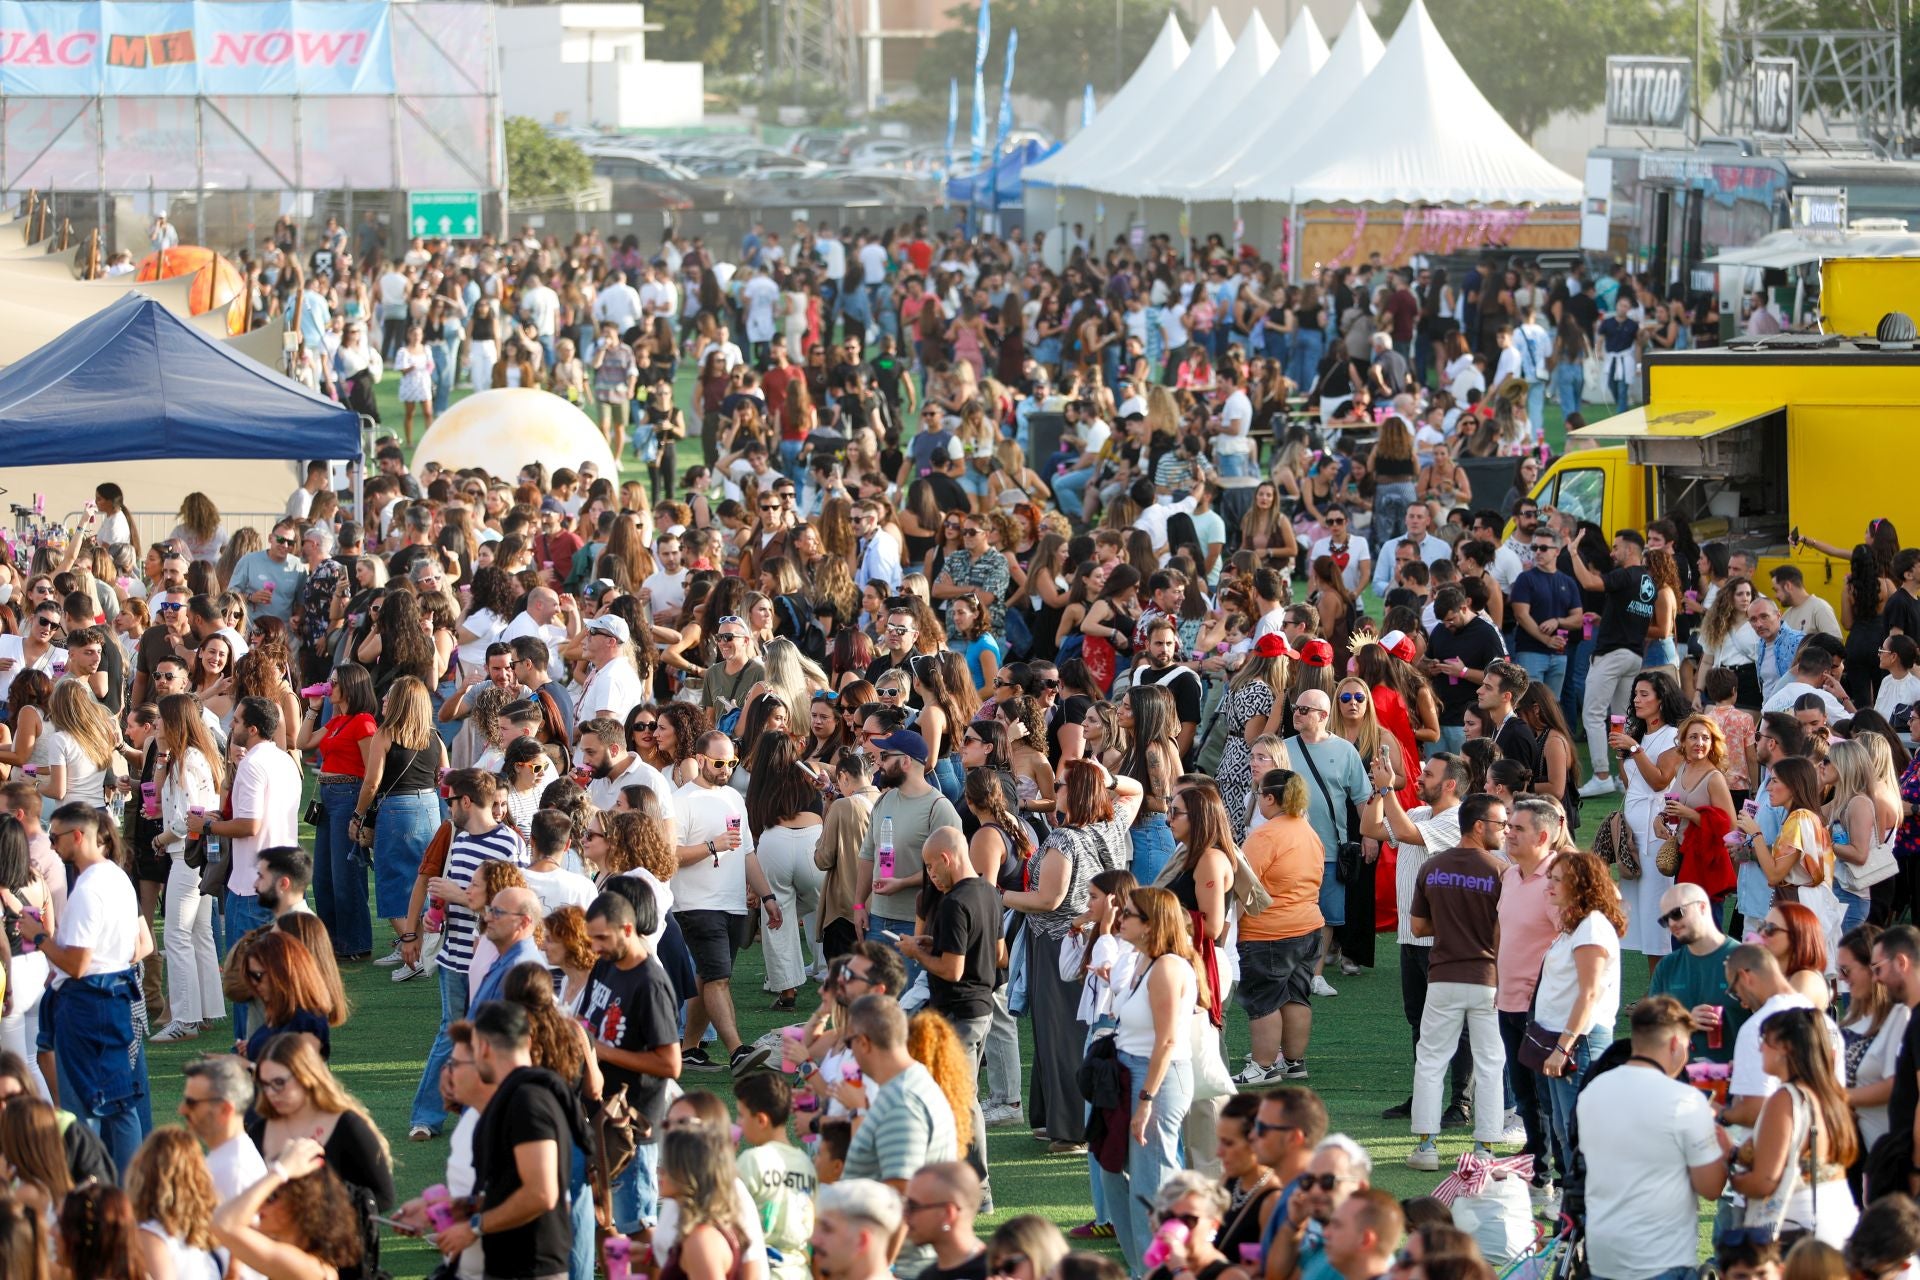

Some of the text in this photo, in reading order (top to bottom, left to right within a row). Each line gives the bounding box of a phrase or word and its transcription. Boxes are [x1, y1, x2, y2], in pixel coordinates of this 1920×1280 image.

[107, 33, 185, 69] ME
[207, 31, 367, 65] NOW!
[1612, 67, 1681, 122] TATTOO
[1756, 69, 1791, 128] BUS
[1426, 868, 1494, 892] element
